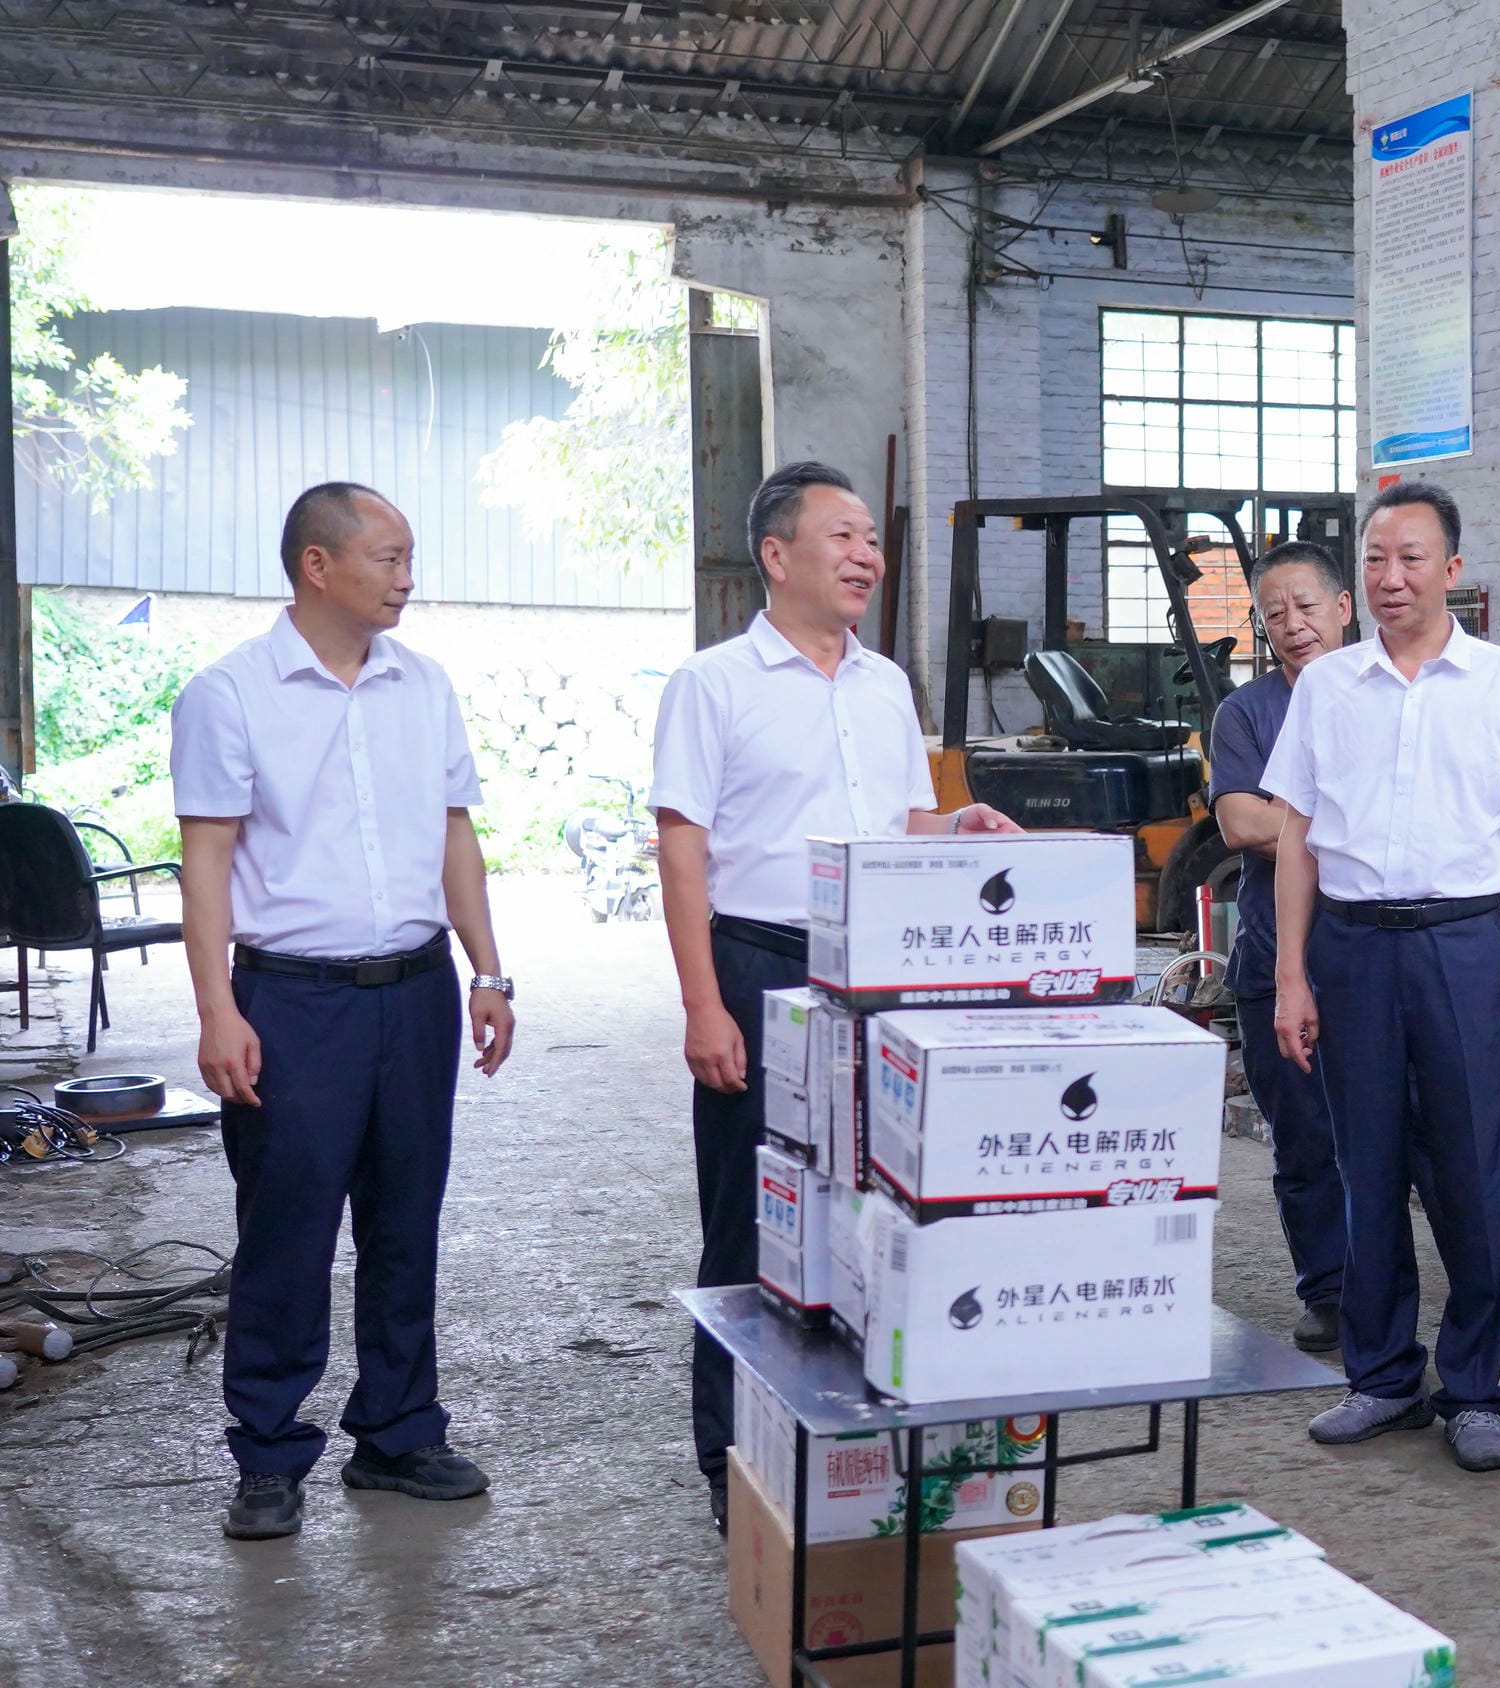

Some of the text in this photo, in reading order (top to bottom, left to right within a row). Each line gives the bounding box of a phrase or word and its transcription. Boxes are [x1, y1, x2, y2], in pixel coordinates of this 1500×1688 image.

[1052, 798, 1071, 807] 30
[901, 920, 1093, 949] 外星人电解质水
[901, 950, 1093, 967] ALIENERGY
[1028, 969, 1101, 997] 专业版
[978, 1128, 1177, 1158] 外星人电解质水
[977, 1158, 1176, 1176] ALIENERGY
[1107, 1178, 1182, 1206] 专业版
[997, 1274, 1176, 1309] 外星人电解质水
[995, 1303, 1175, 1327] ALIENERGY
